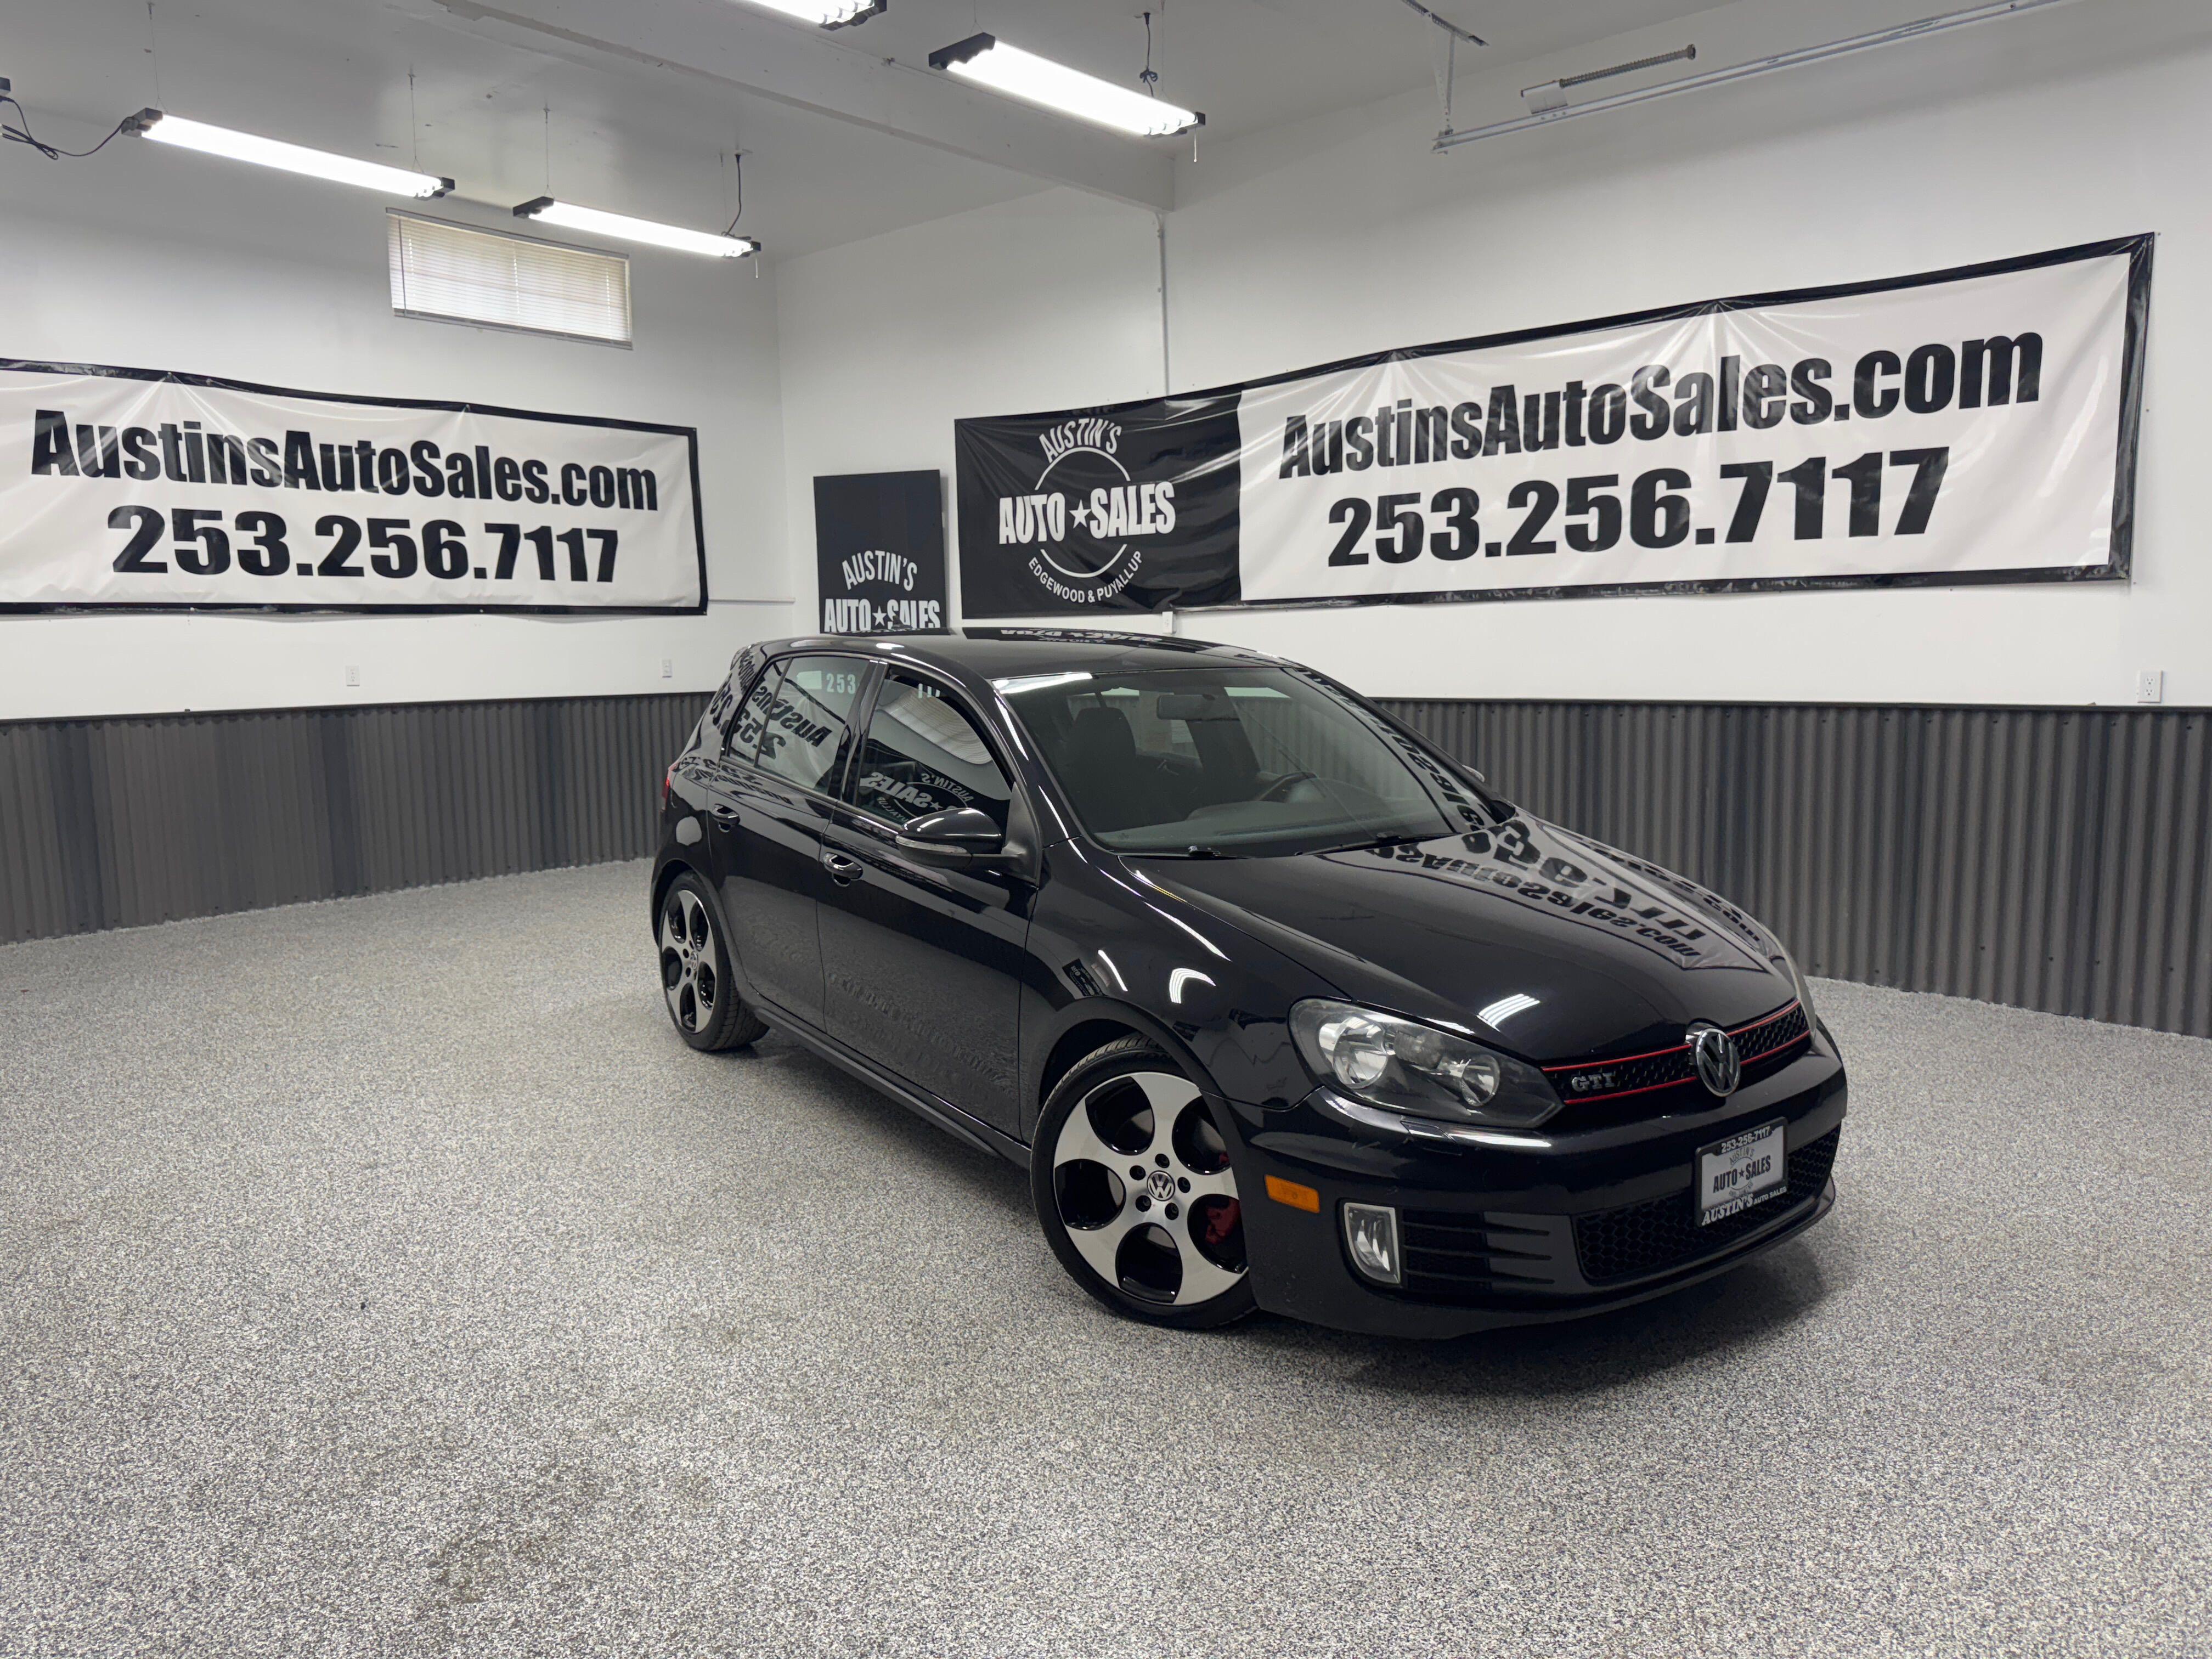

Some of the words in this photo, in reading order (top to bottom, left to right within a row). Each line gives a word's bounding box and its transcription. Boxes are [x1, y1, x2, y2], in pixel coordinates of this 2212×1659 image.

[1279, 329, 2044, 478] AustinsAutoSales.com
[31, 409, 658, 511] AustinsAutoSales.com
[1039, 418, 1122, 463] AUSTIN'S
[999, 492, 1065, 544] AUTO
[1090, 481, 1176, 539] SALES
[1328, 447, 1950, 567] 253.256.7117
[108, 505, 618, 583] 253.256.7117
[842, 550, 918, 591] AUSTIN'S
[1028, 557, 1085, 603] EDGEWOOD
[1088, 590, 1096, 603] &
[1097, 551, 1142, 601] PUYALLUP
[824, 599, 871, 633] AUTO
[826, 673, 856, 694] 253
[1571, 1072, 1616, 1092] GTI
[1721, 1126, 1770, 1153] 253-256-7117
[1712, 1169, 1738, 1193] AUTO
[1746, 1155, 1771, 1180] SALES
[1702, 1194, 1754, 1226] AUSTIN'S
[1753, 1194, 1769, 1205] AUTO
[1769, 1186, 1787, 1198] SALES
